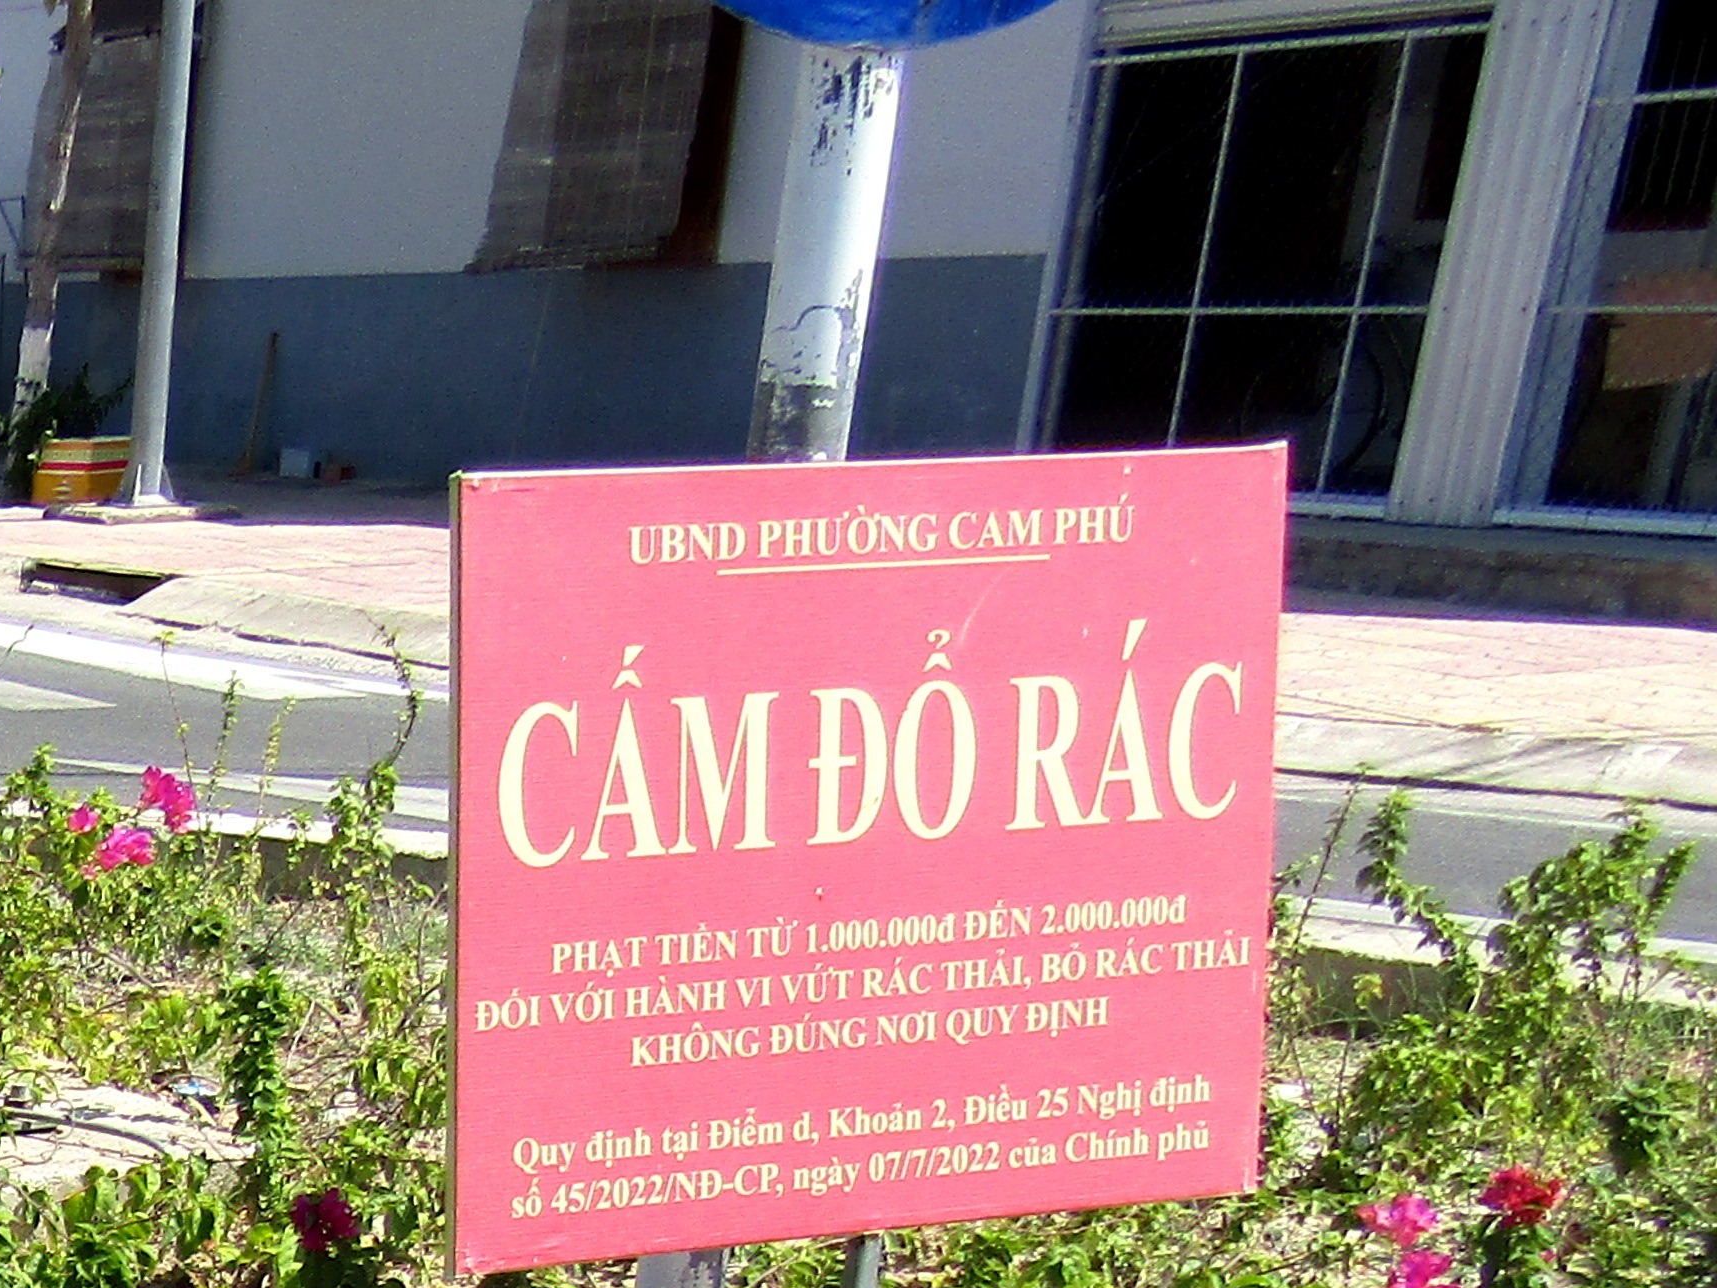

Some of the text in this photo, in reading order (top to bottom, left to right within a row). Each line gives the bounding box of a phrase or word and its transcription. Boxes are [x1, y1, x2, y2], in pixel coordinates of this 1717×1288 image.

[627, 492, 1135, 565] UBND PHƯỜNG CAM PHÚ
[498, 617, 1243, 868] CẤM ĐỔ RÁC
[474, 929, 1251, 1032] ĐỐI VỚI HÀNH VI VỨT RÁC THẢI, BỎ RÁC THẢI
[552, 894, 1187, 978] PHẠT TIỀN TỪ 1.000.000đ ĐẾN 2.000.000đ
[630, 996, 1110, 1067] KHÔNG ĐÚNG NƠI QUY ĐỊNH
[511, 1119, 1210, 1219] số 45/2022/NĐ-CP, ngày 07/7/2022 của Chính phủ
[513, 1073, 1211, 1175] Quy định tại Điểm d, Khoản 2, Điều 25 Nghị định
